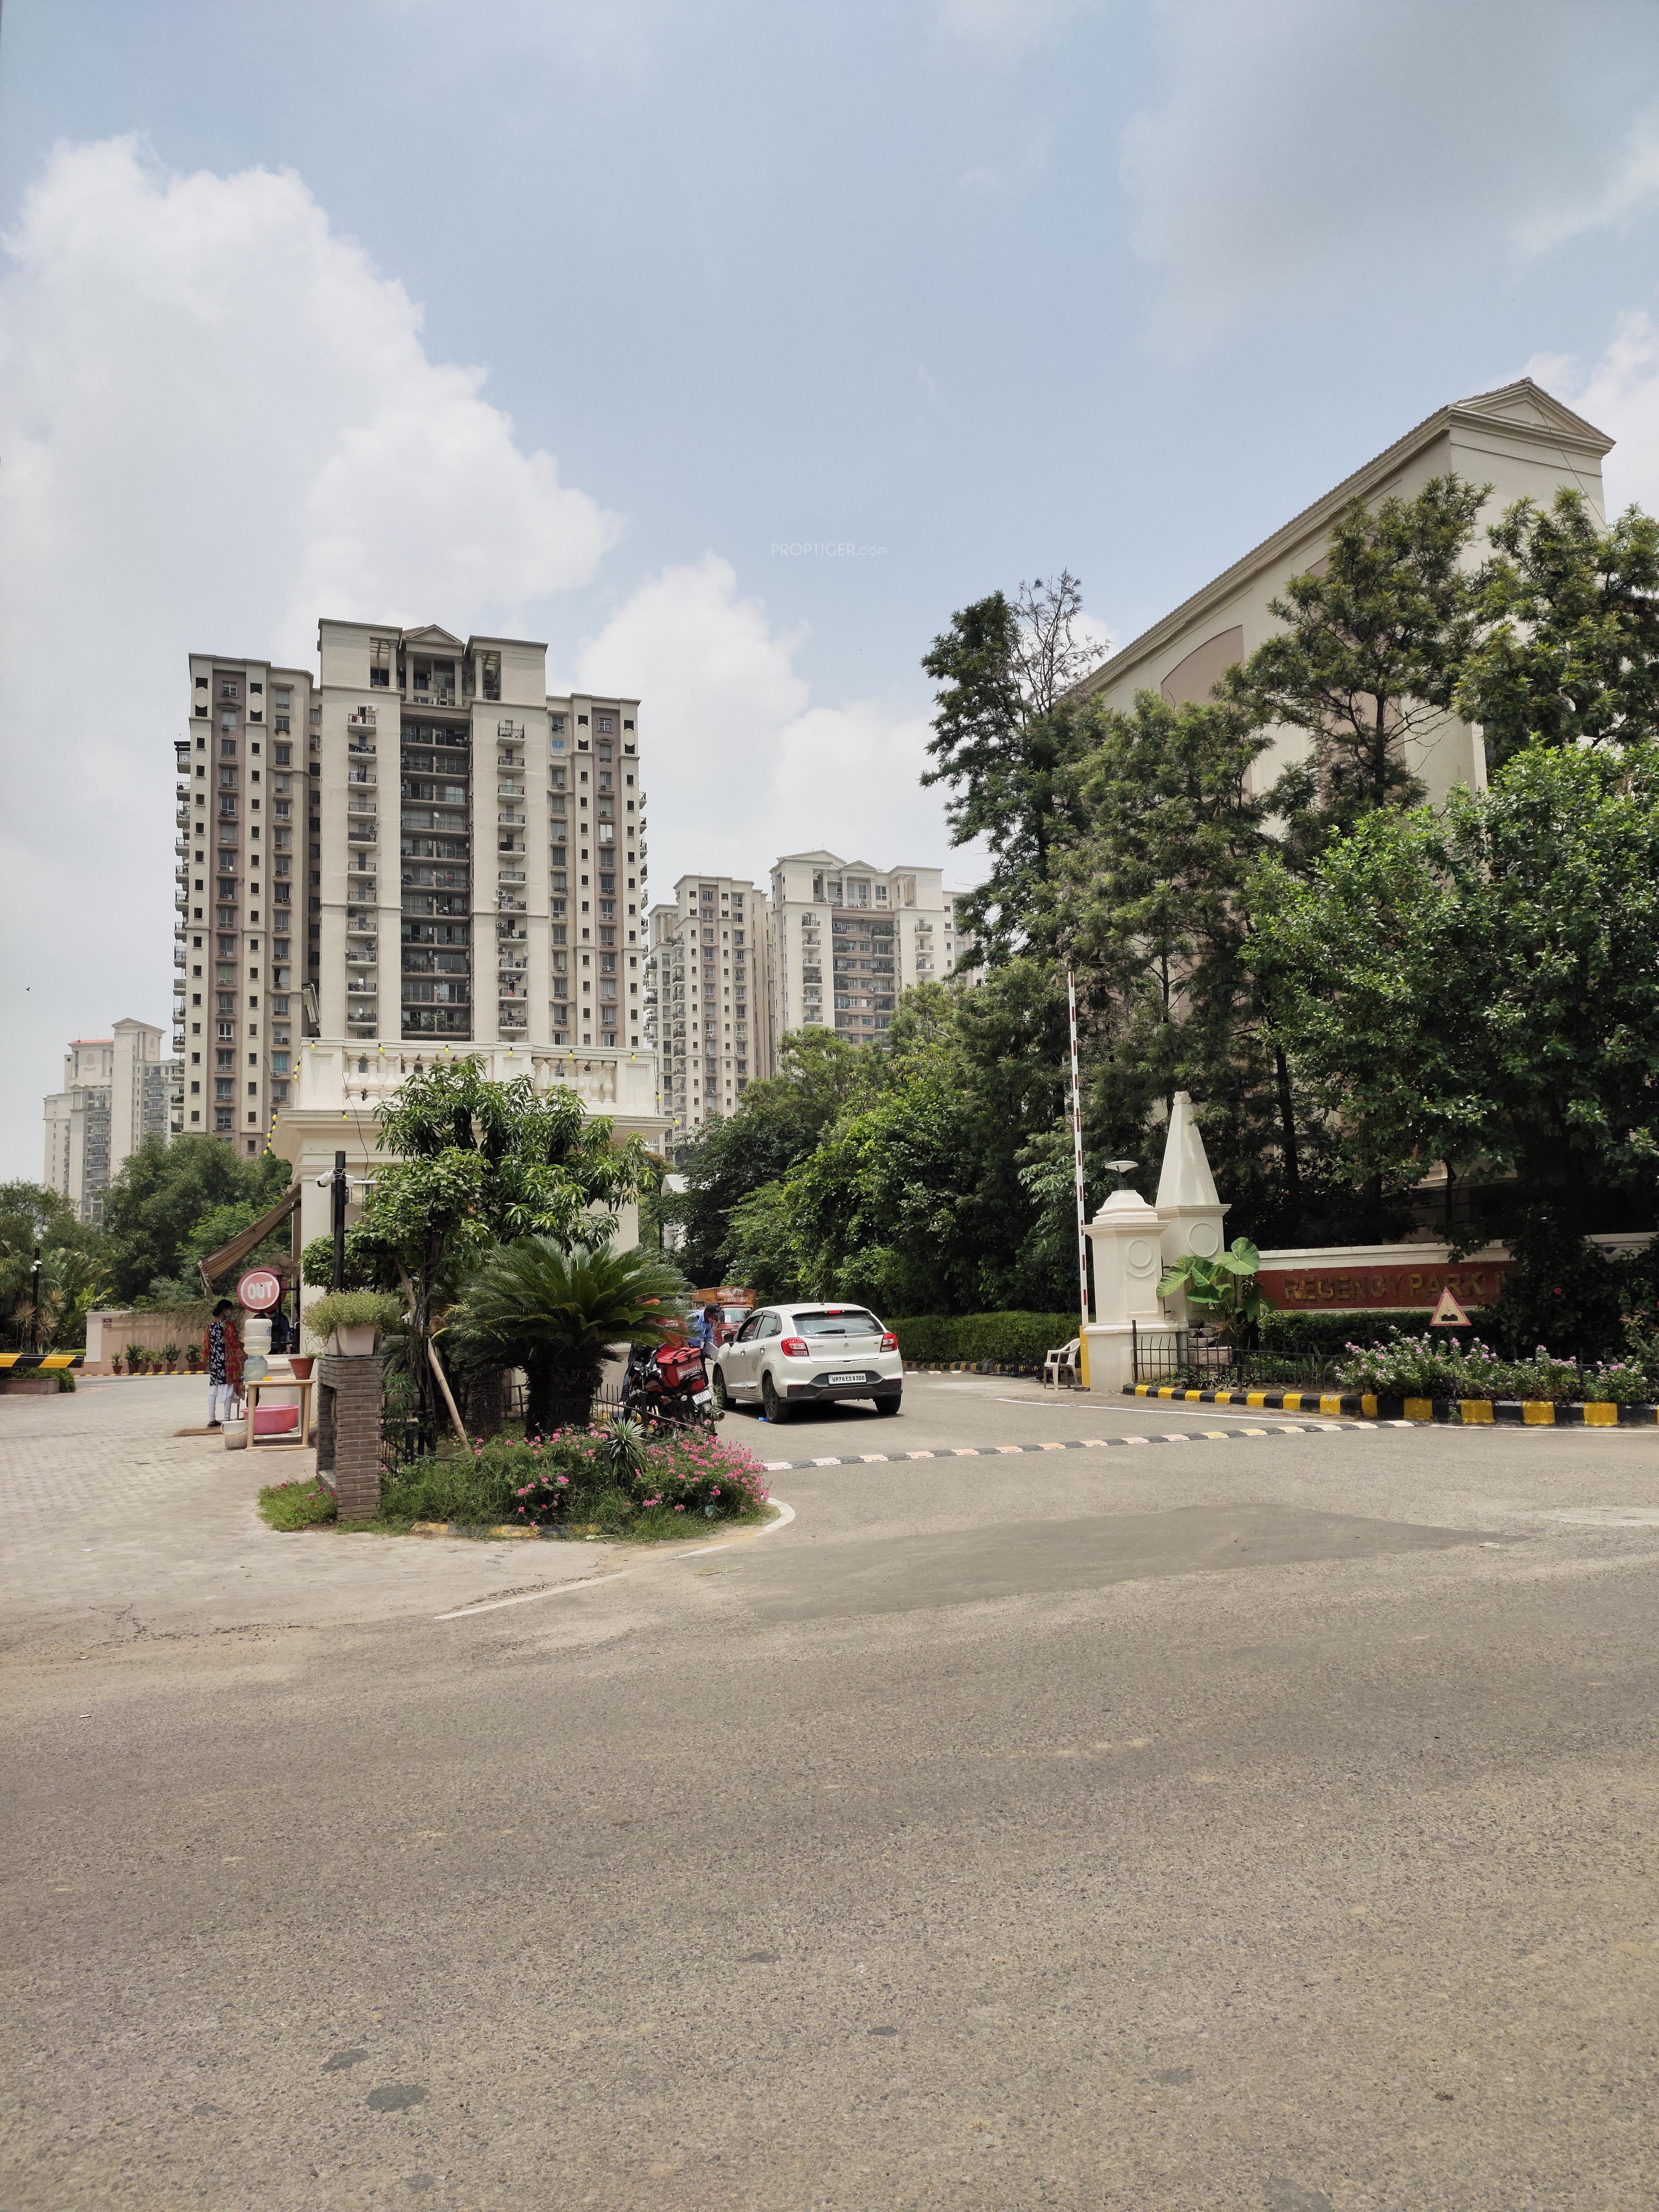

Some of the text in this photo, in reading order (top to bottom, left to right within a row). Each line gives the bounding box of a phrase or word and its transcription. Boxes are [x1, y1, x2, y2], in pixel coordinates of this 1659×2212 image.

[248, 1281, 273, 1300] OUT
[1284, 1274, 1405, 1300] REGENCY
[1409, 1271, 1484, 1297] PARK
